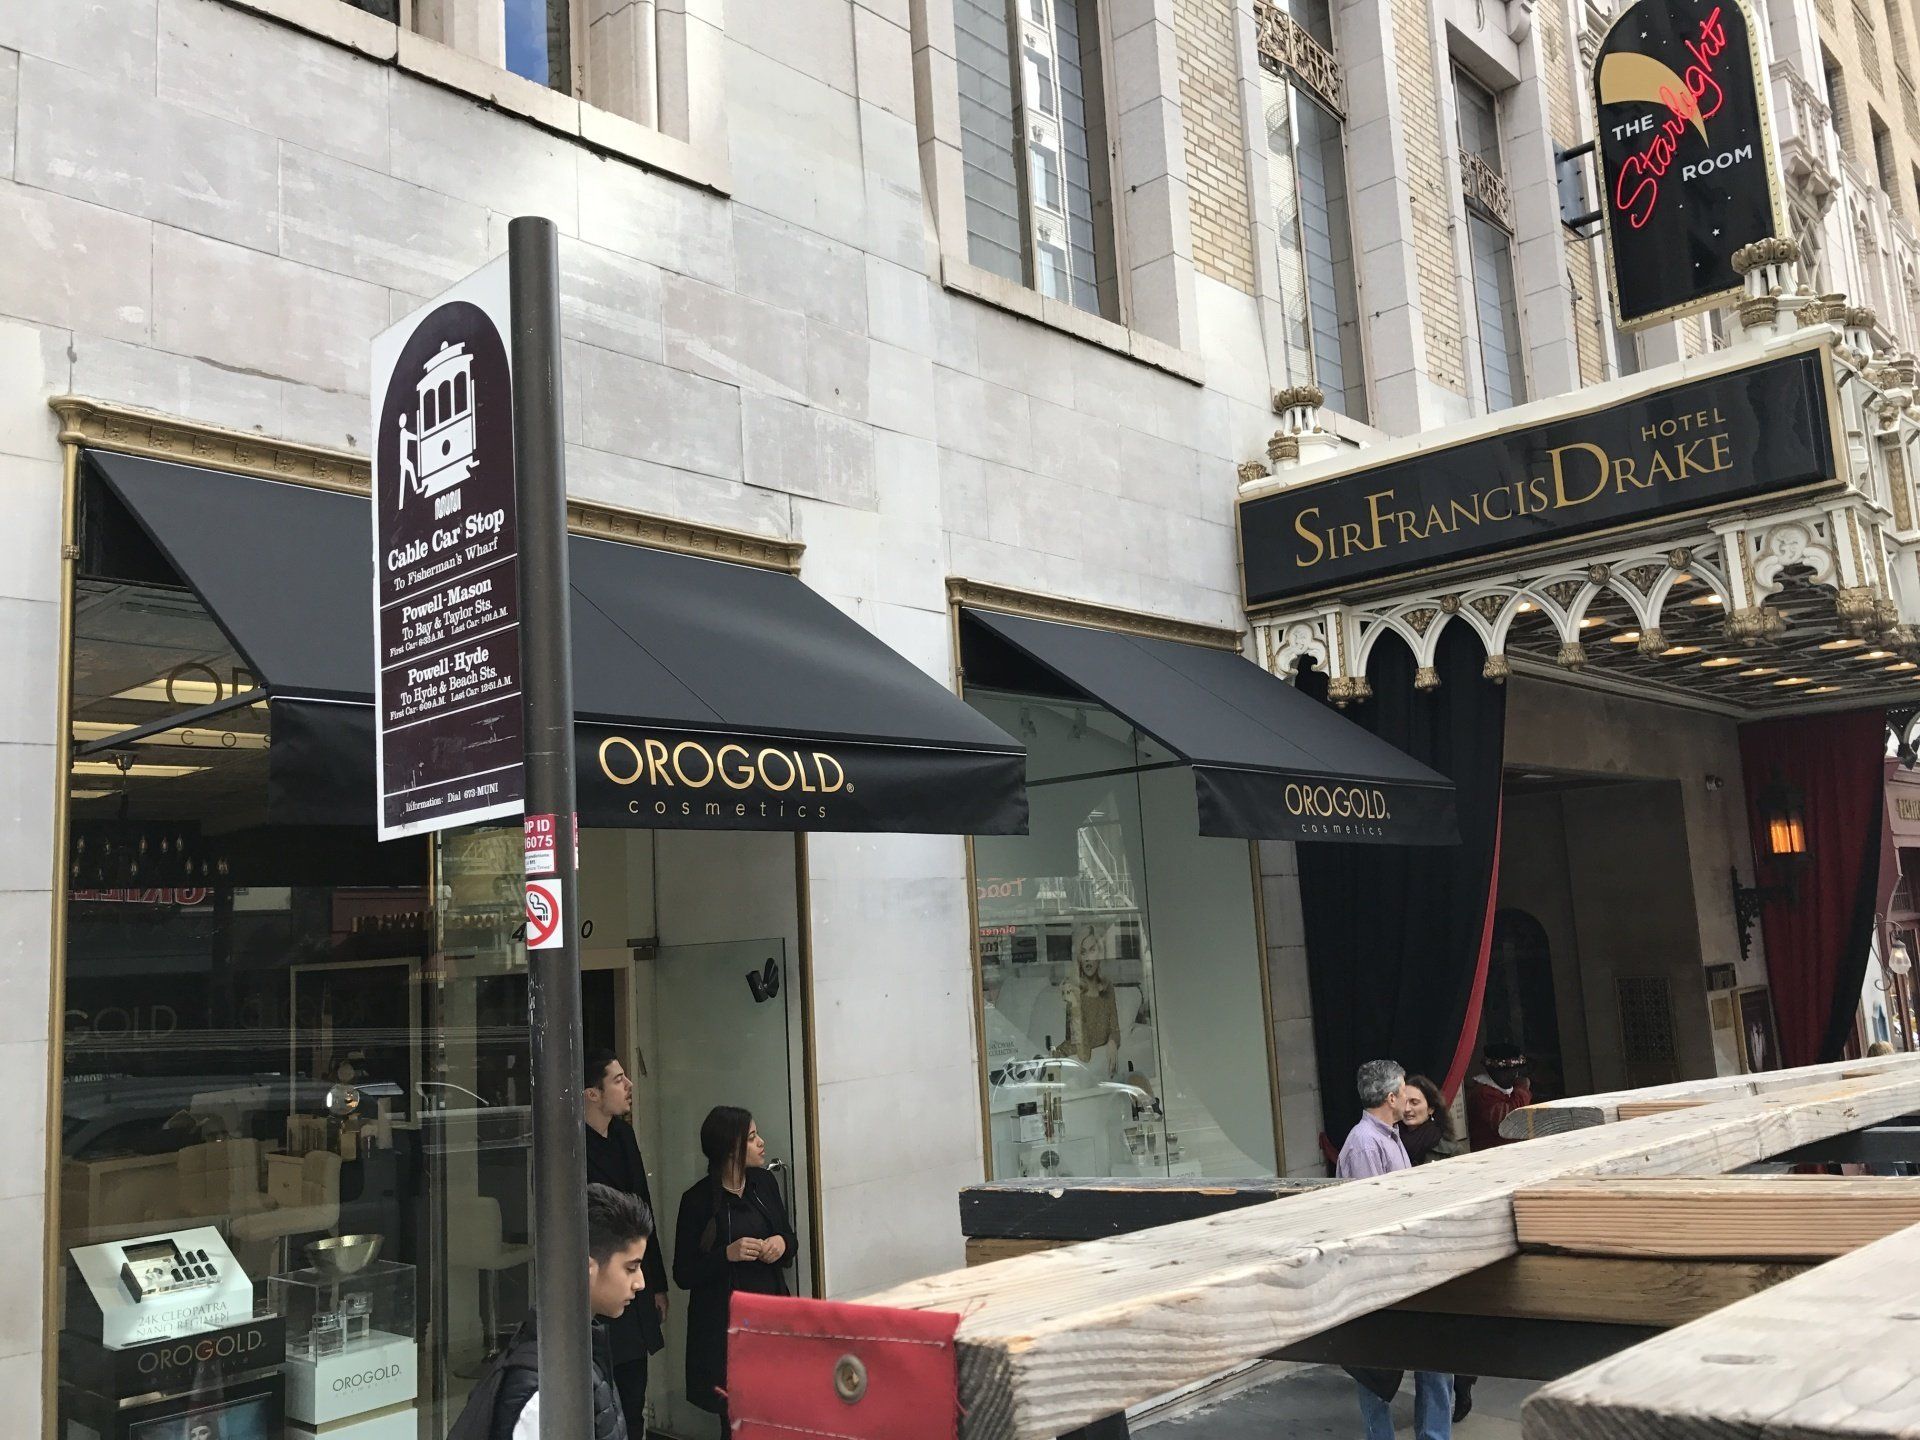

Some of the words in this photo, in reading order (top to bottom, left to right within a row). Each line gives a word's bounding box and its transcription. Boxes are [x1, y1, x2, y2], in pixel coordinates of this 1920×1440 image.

[1612, 114, 1655, 141] THE
[1617, 6, 1726, 229] Starlight
[1682, 144, 1753, 182] ROOM
[1641, 407, 1727, 443] HOTEL
[388, 539, 429, 571] Cable
[432, 528, 460, 551] Car
[465, 508, 504, 539] Stop
[394, 578, 405, 591] To
[407, 553, 463, 586] Fisherman's
[465, 536, 499, 561] Wharf
[402, 627, 413, 641] To
[415, 621, 433, 636] Bay
[434, 617, 442, 629] &
[443, 606, 473, 626] Taylor
[475, 599, 493, 614] Sts.
[389, 645, 404, 657] First
[451, 623, 465, 635] Last
[400, 692, 412, 706] To
[413, 684, 441, 703] Hyde
[439, 681, 447, 694] &
[449, 670, 478, 691] Beach
[479, 665, 498, 681] Sts.
[389, 708, 405, 721] First
[450, 691, 465, 702] Last
[447, 791, 461, 803] Dial
[628, 800, 826, 818] cosmetics
[1285, 783, 1386, 819] OROGOLD
[537, 819, 550, 832] ID
[1301, 823, 1383, 836] cosmetics
[161, 1301, 228, 1322] CLEOPATRA
[138, 1330, 262, 1375] OROGOLD
[333, 1364, 400, 1392] OROGOLD
